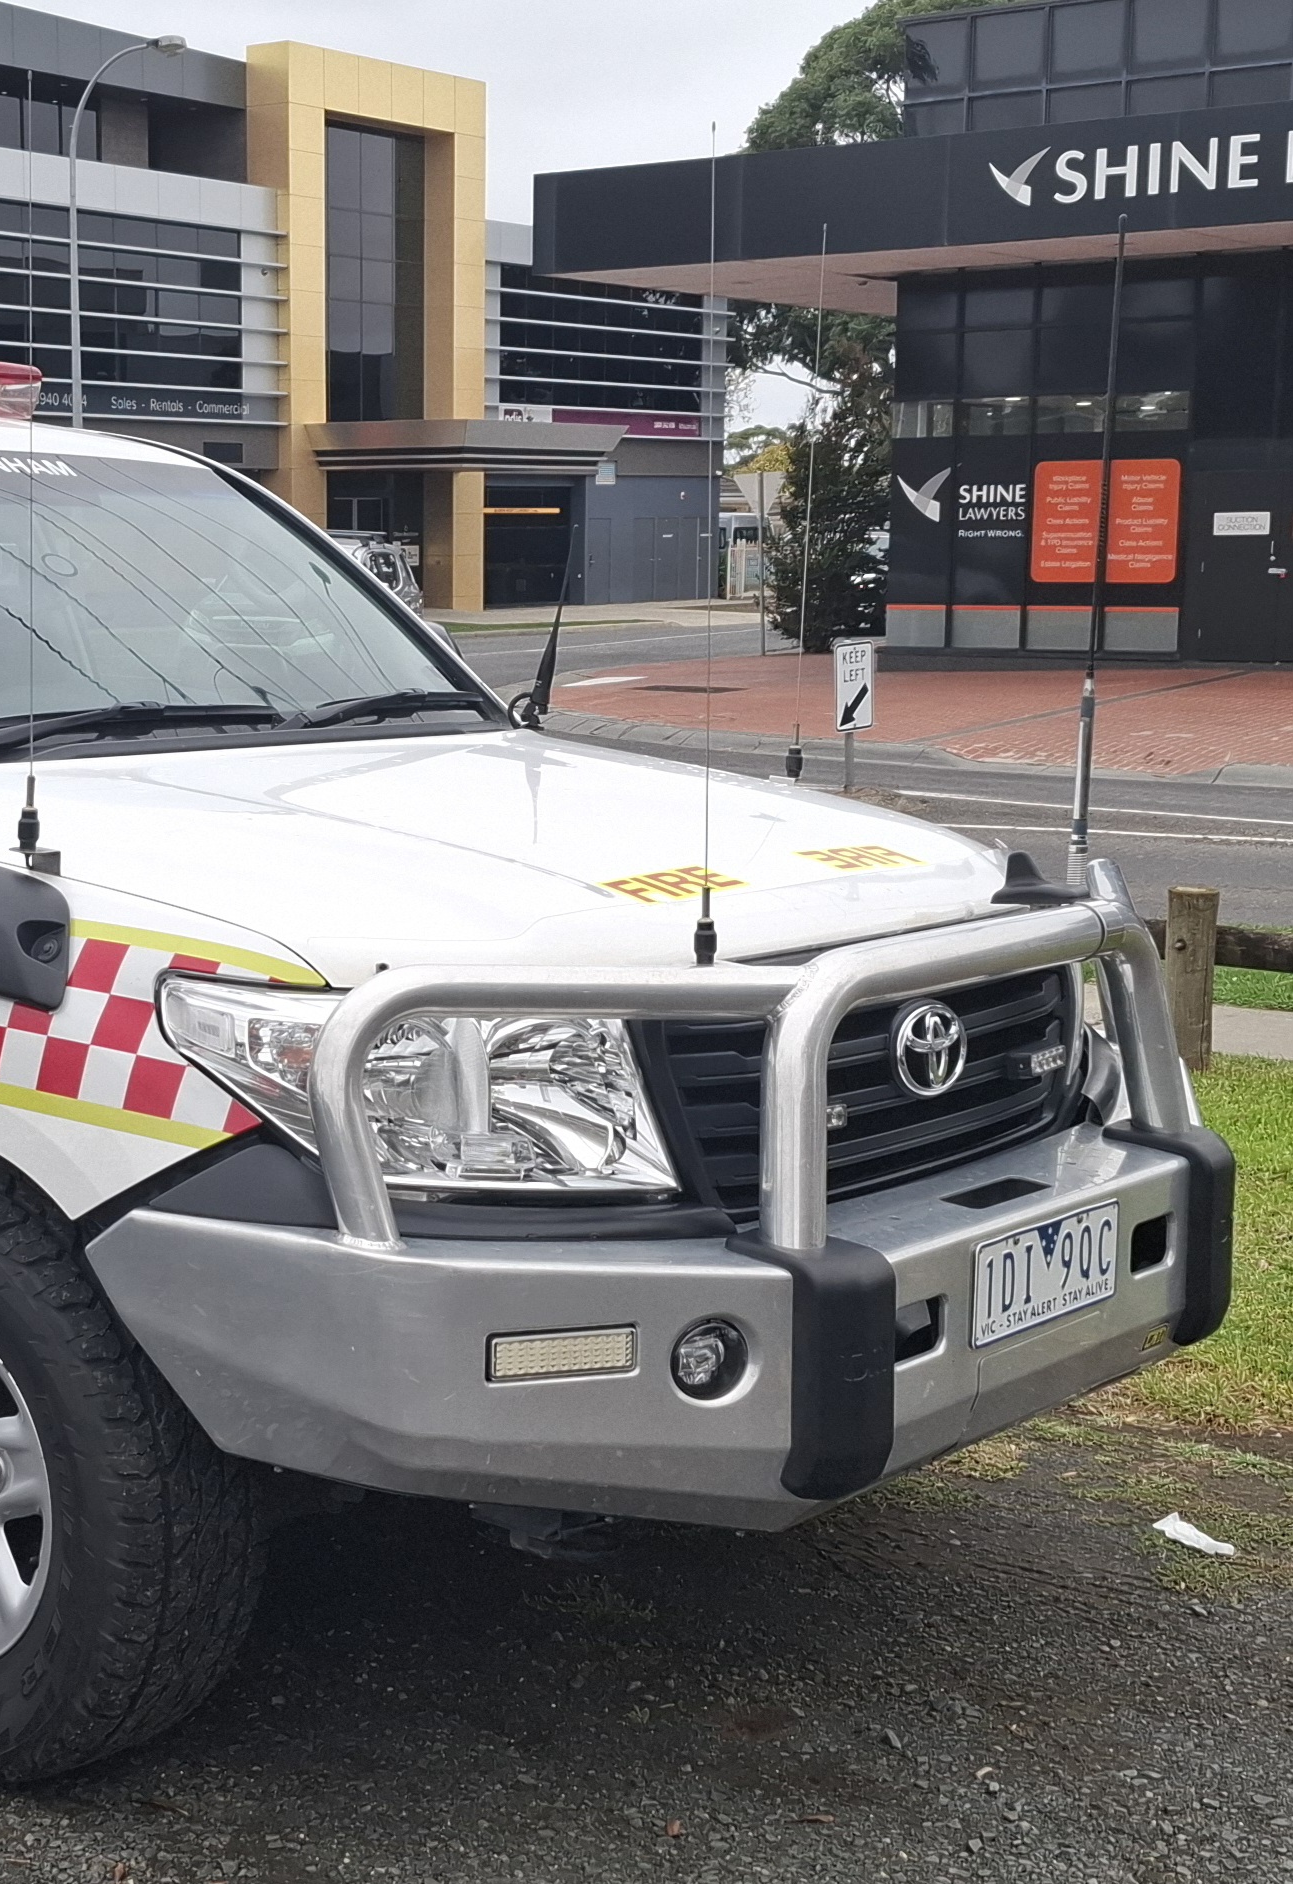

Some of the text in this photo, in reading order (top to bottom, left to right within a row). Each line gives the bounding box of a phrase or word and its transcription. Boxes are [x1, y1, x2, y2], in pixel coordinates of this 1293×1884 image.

[1053, 133, 1261, 204] SHINE
[36, 392, 59, 406] 940
[111, 396, 137, 410] Sales
[150, 398, 184, 412] Rentals
[196, 401, 250, 414] Commercial
[959, 484, 1027, 504] SHINE
[959, 506, 1025, 520] LAWYERS
[843, 650, 866, 665] KEEP
[843, 668, 865, 683] LEFT
[599, 866, 746, 903] FIRE
[980, 1319, 996, 1338] VIC
[1006, 1308, 1029, 1328] STAY
[1031, 1298, 1057, 1318] ALERT
[1062, 1288, 1083, 1307] STAY
